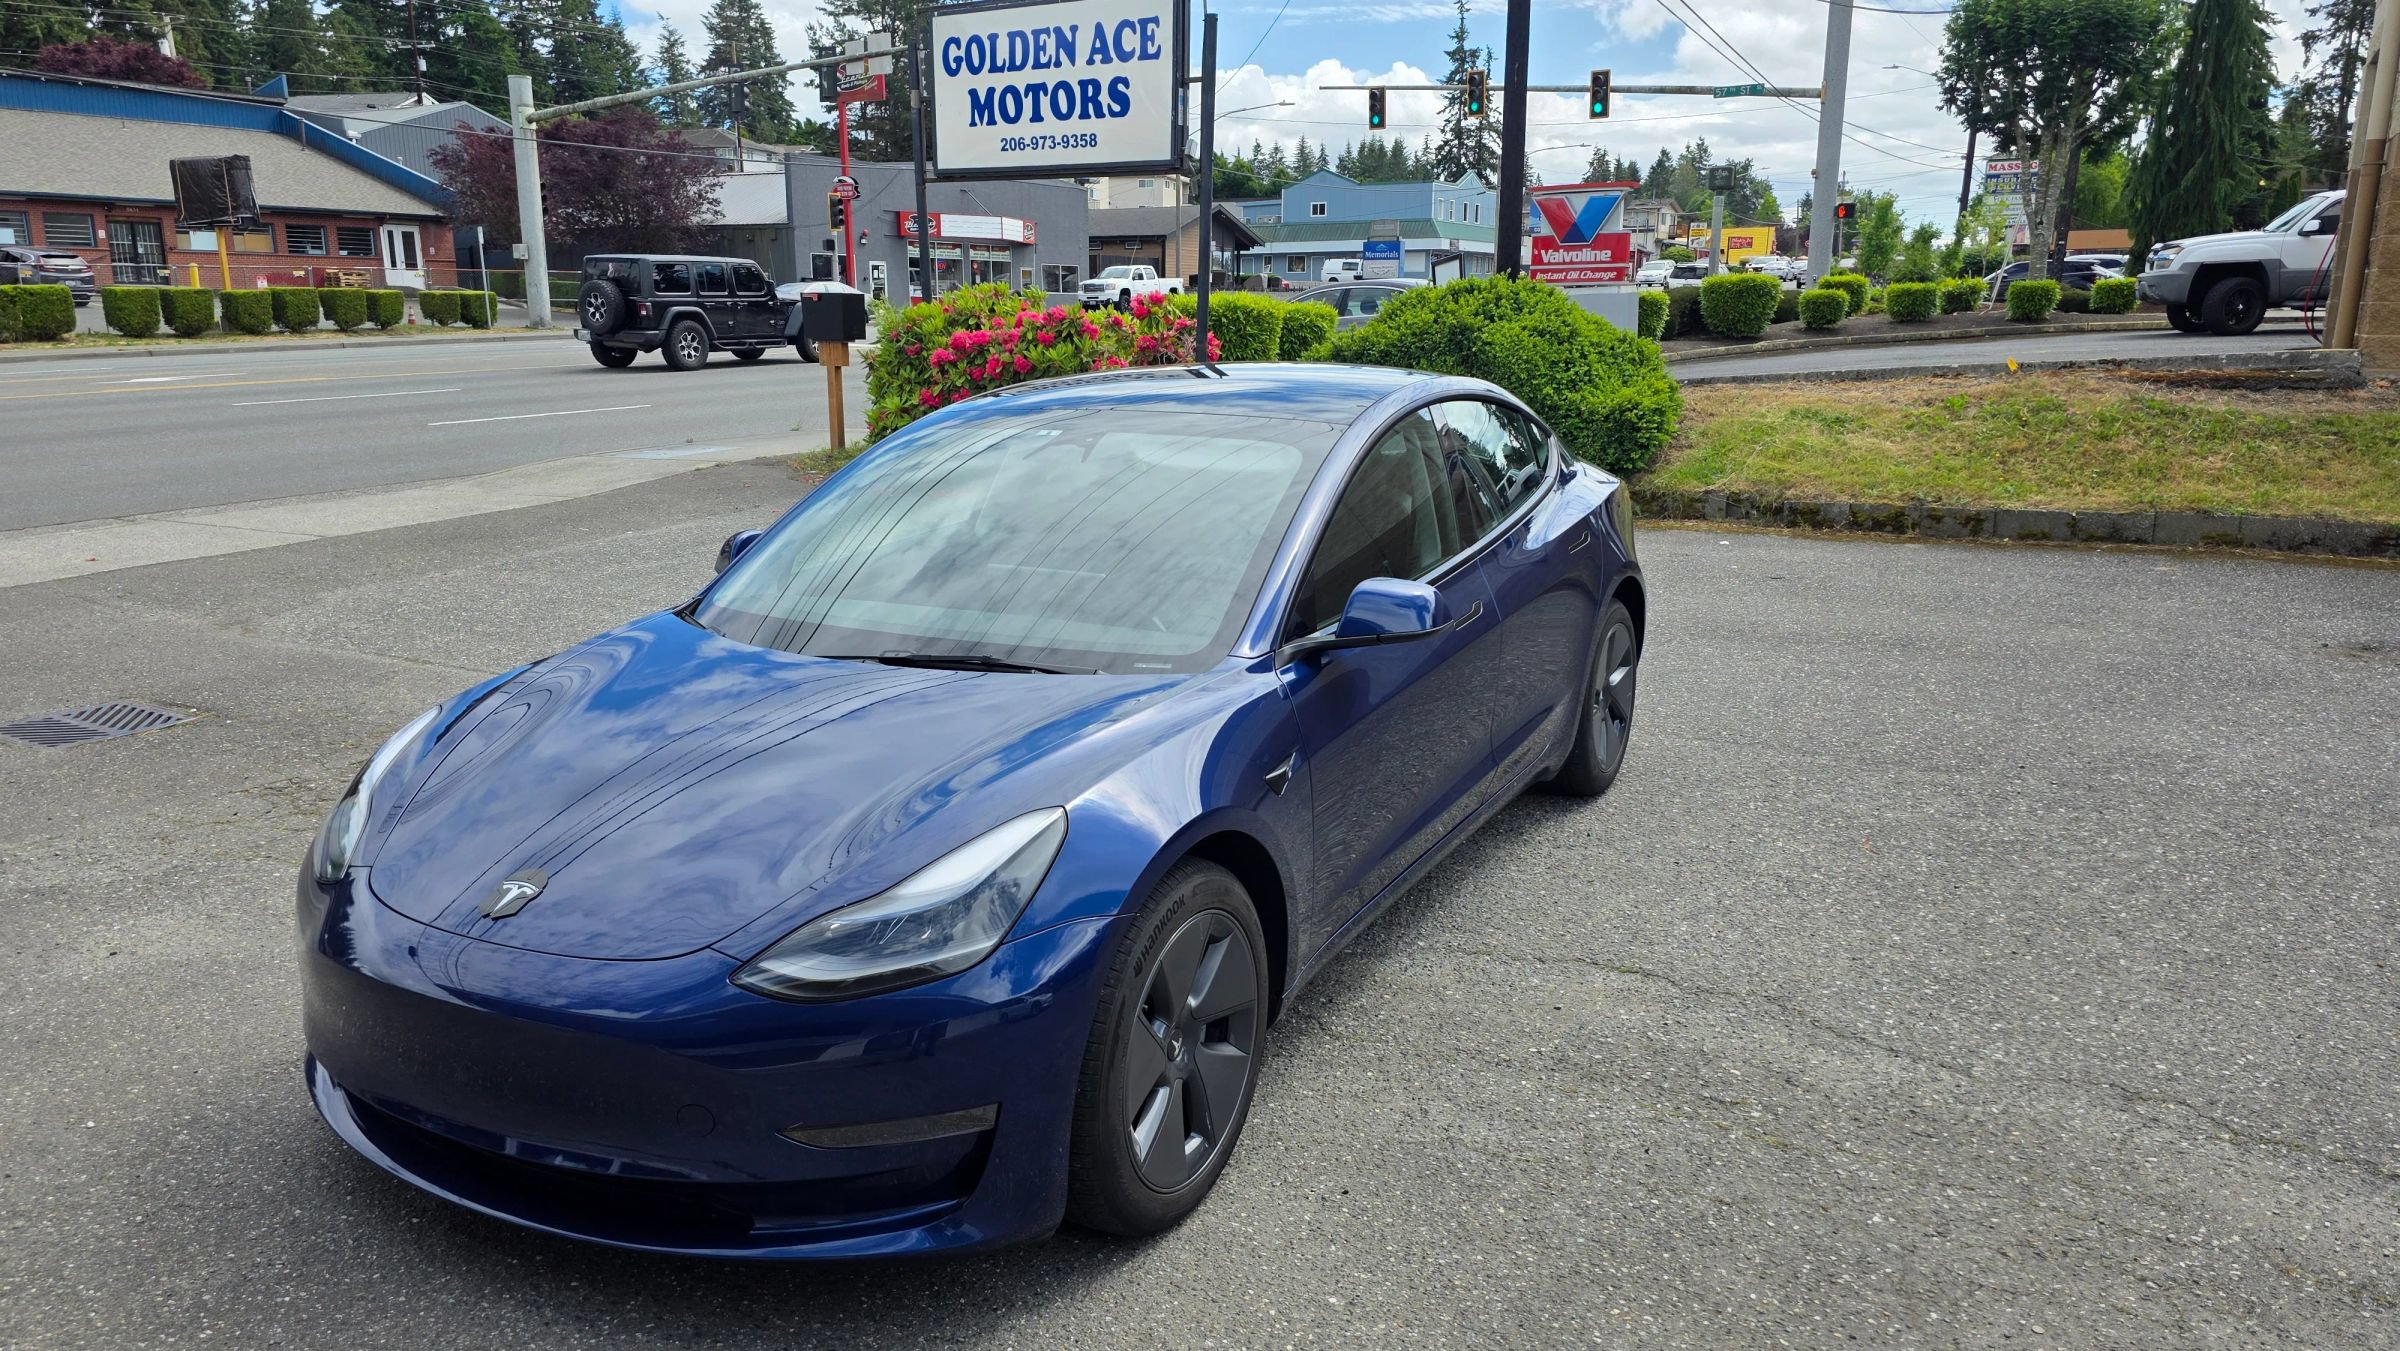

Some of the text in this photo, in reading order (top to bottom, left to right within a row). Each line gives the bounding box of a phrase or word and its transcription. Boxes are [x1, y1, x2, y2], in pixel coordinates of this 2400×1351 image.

[942, 15, 1162, 77] GOLDEN ACE
[1740, 86, 1751, 95] ST
[968, 76, 1131, 128] MOTORS
[1000, 133, 1098, 152] 206-973-9358
[1988, 162, 2038, 172] MASSG
[1541, 248, 1612, 263] Valvoline
[1567, 271, 1580, 279] Oil
[1580, 270, 1617, 280] Change
